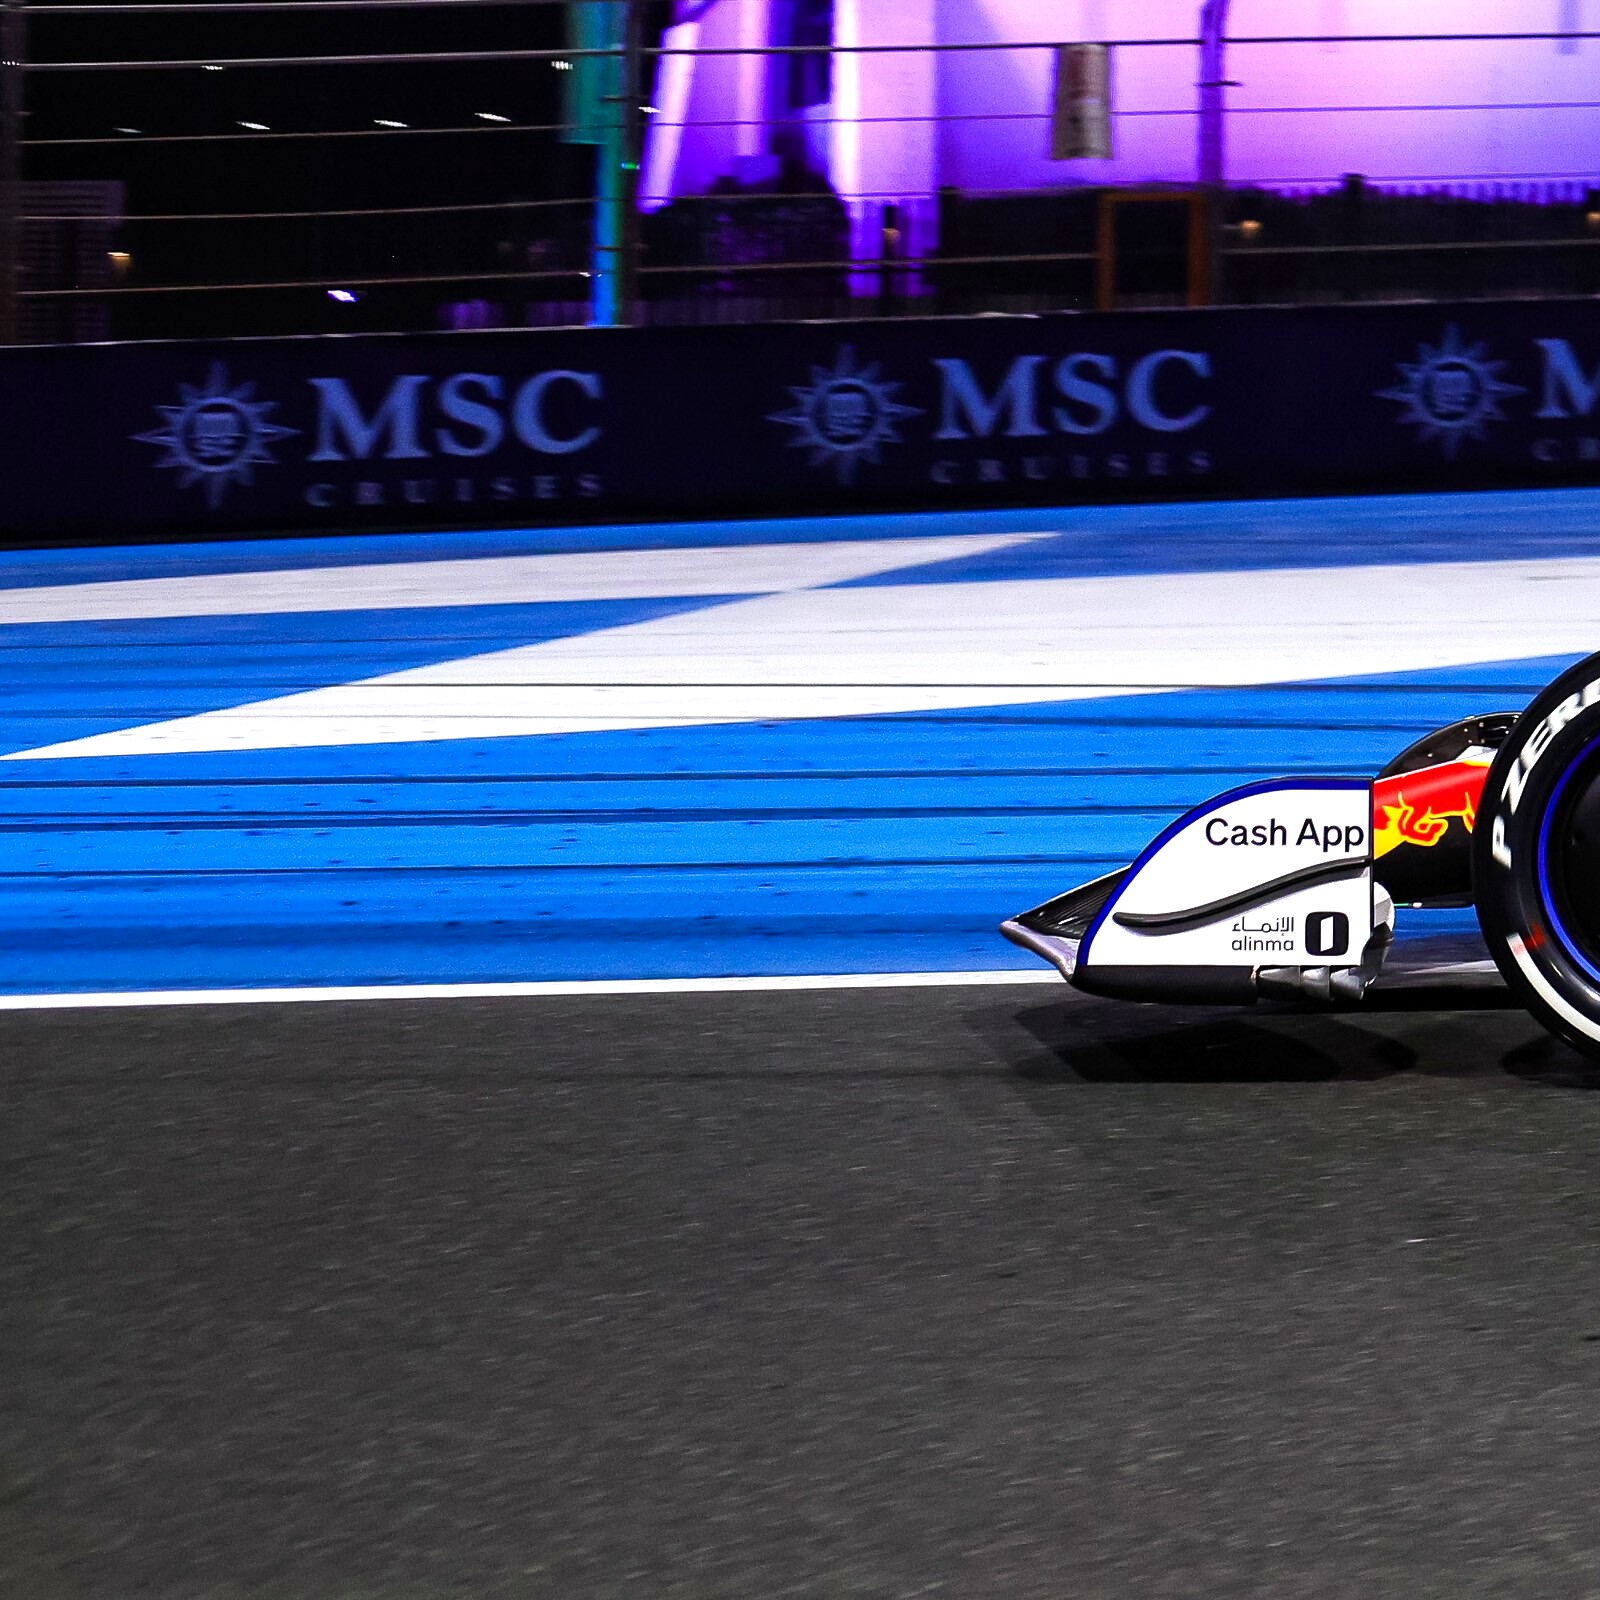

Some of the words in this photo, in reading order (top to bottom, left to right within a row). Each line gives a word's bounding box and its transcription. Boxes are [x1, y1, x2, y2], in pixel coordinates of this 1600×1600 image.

[306, 369, 602, 462] MSC
[931, 349, 1212, 440] MSC
[1205, 818, 1287, 847] Cash
[1296, 818, 1364, 852] App
[1231, 935, 1294, 951] alinma
